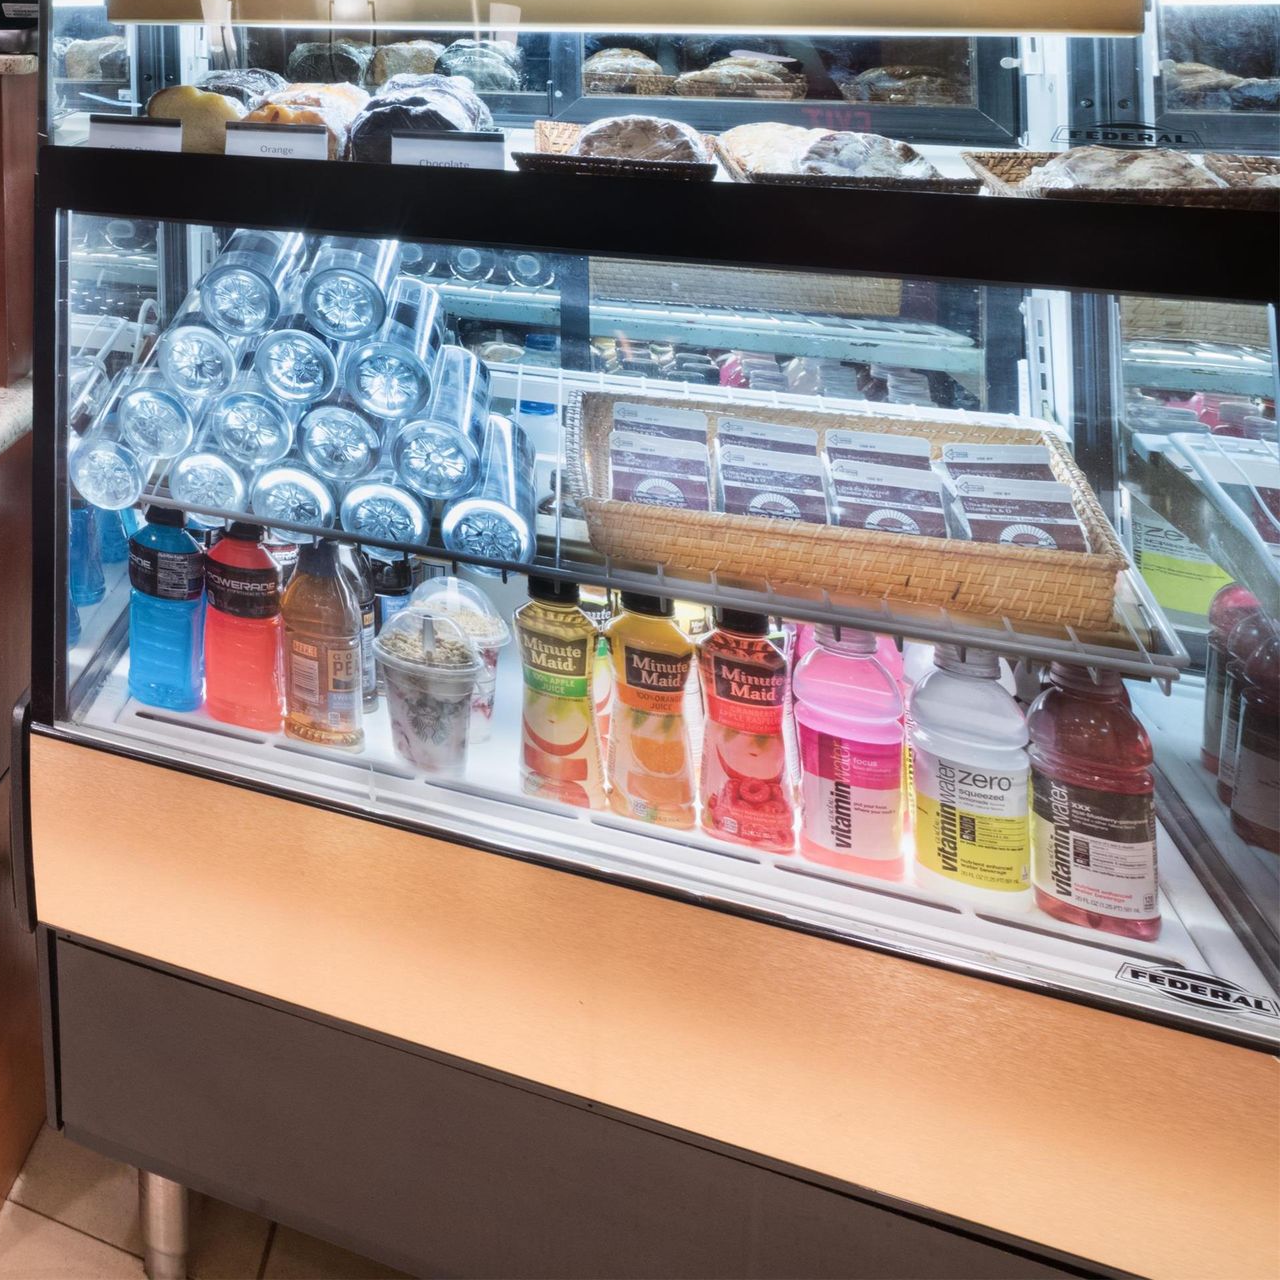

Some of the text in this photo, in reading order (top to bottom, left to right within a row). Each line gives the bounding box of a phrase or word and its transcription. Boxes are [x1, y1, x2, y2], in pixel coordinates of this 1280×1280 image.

[1069, 130, 1190, 144] FEDERAL
[260, 144, 294, 156] Orange
[523, 634, 582, 659] Minute
[532, 652, 574, 672] Maid
[631, 654, 688, 674] Minute
[640, 671, 682, 687] Maid
[721, 665, 782, 687] Minute
[730, 682, 777, 701] Maid
[853, 756, 878, 767] focus
[958, 769, 1011, 791] zero
[959, 788, 1005, 801] squeezed
[1130, 968, 1272, 1013] FEDERAL
